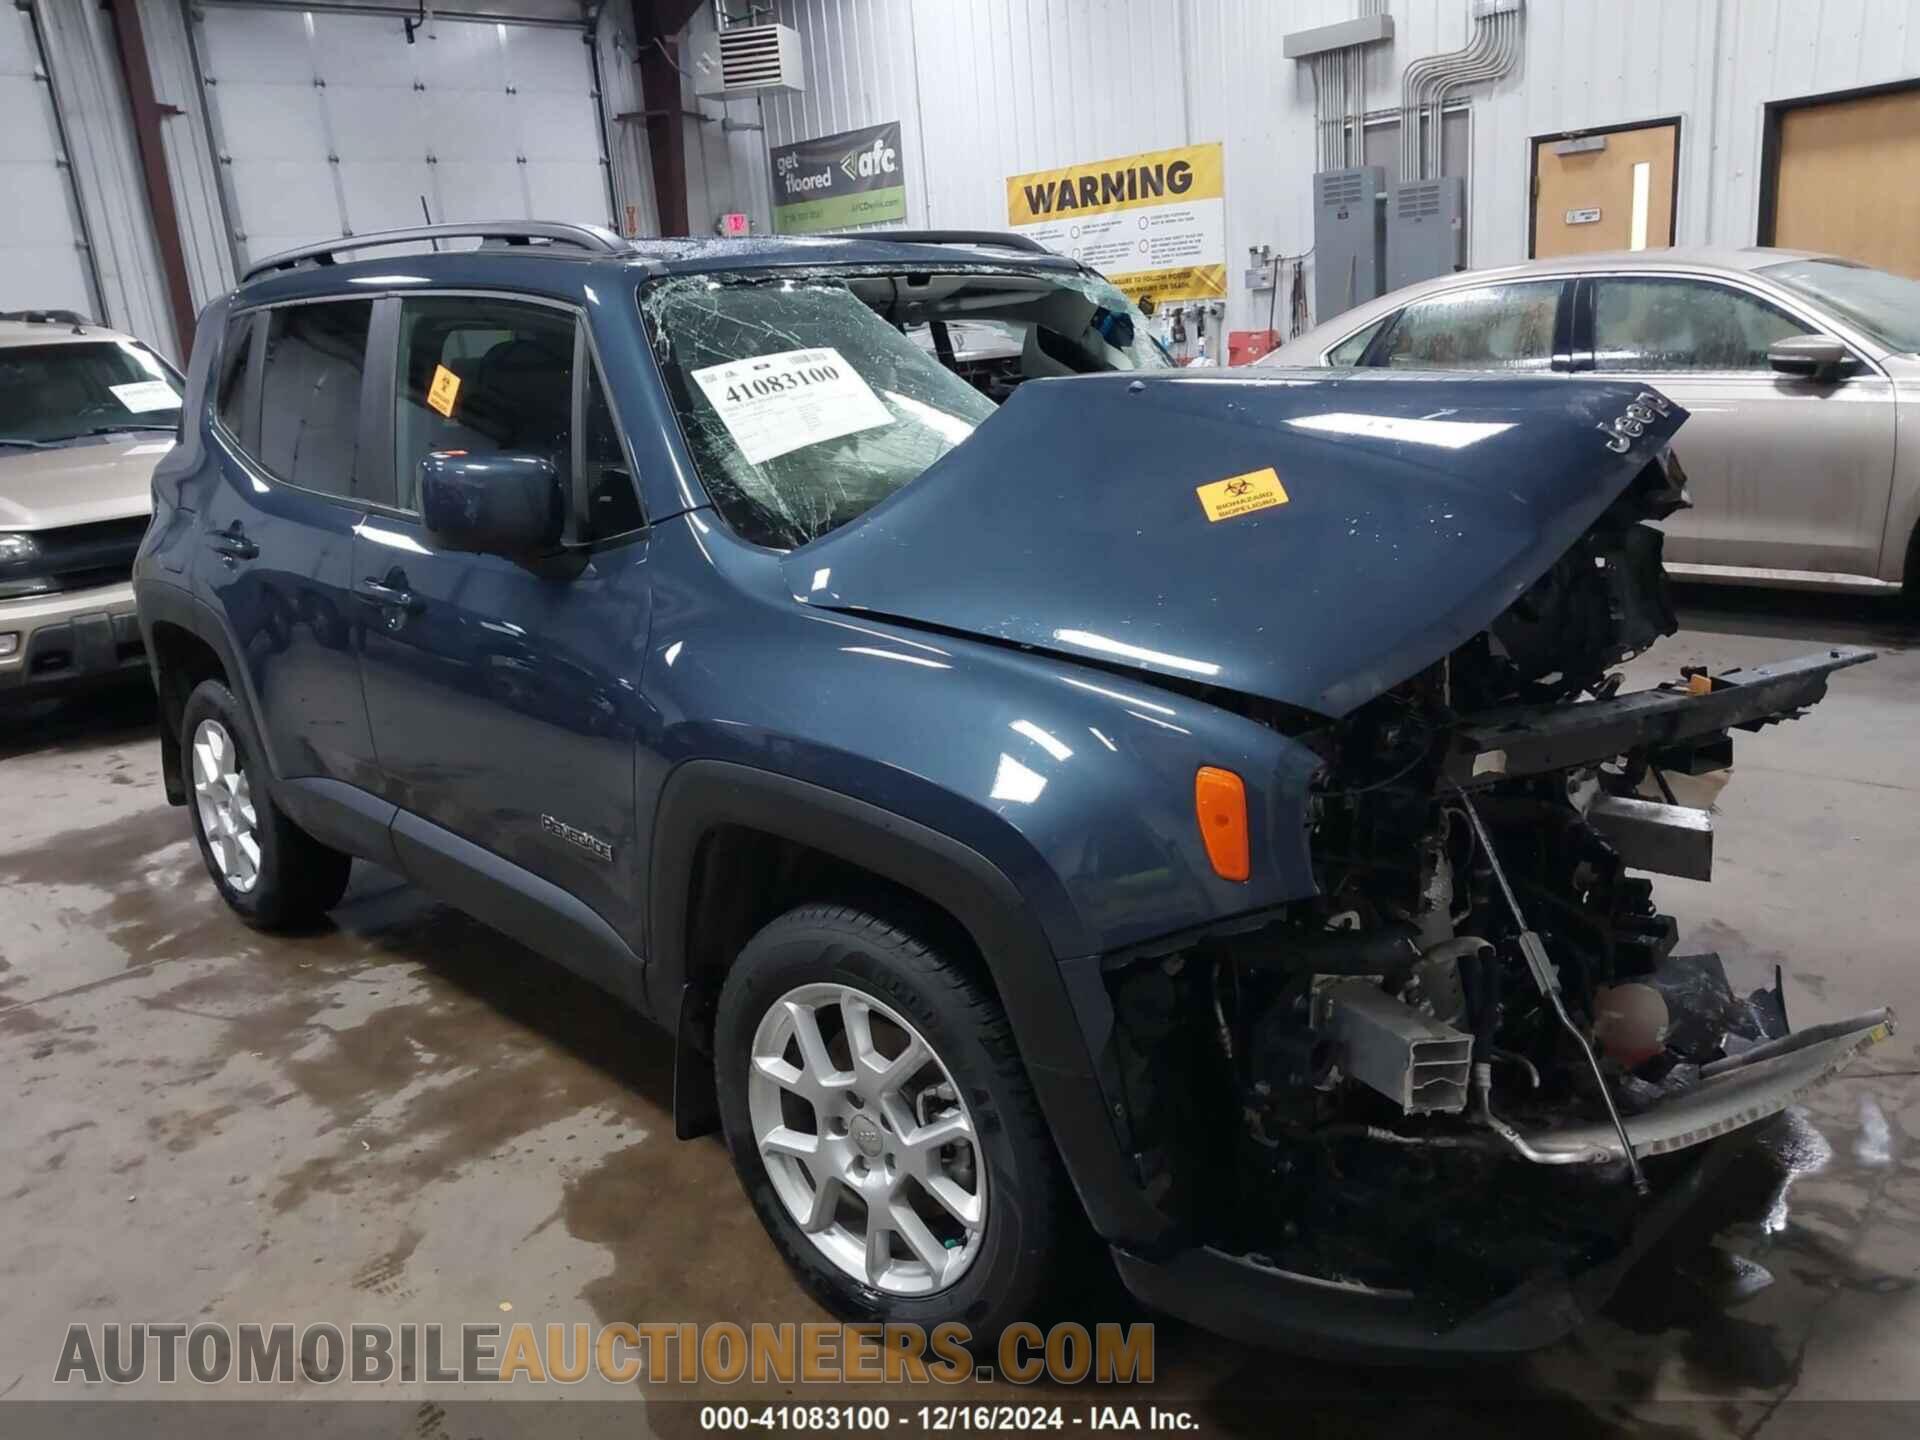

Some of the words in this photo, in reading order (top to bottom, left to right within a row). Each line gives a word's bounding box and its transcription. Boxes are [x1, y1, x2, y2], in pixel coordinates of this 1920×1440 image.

[776, 151, 799, 176] get
[858, 139, 897, 178] afc
[785, 165, 832, 193] floored
[1024, 160, 1193, 215] WARNING
[726, 365, 840, 402] 41083100
[1595, 391, 1670, 454] Jeep
[1215, 491, 1274, 511] BIOHAZARD
[541, 813, 613, 862] RENEGADE
